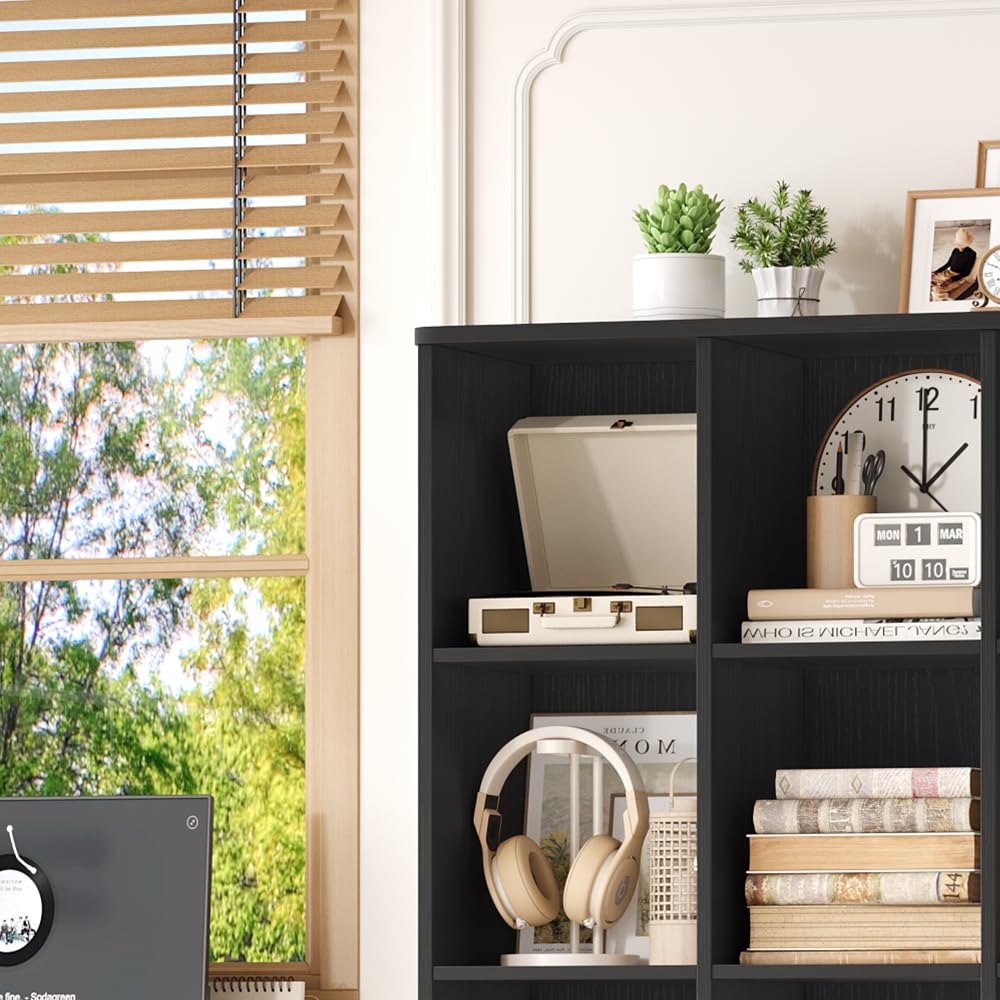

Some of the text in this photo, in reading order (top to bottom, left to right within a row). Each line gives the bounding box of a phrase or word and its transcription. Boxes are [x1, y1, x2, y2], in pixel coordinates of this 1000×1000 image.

[875, 397, 895, 422] 11
[915, 386, 939, 411] 12
[969, 395, 978, 419] 1
[876, 526, 963, 543] MON 1 MAR
[892, 562, 913, 578] 10
[925, 562, 944, 578] 10
[943, 873, 962, 898] 144
